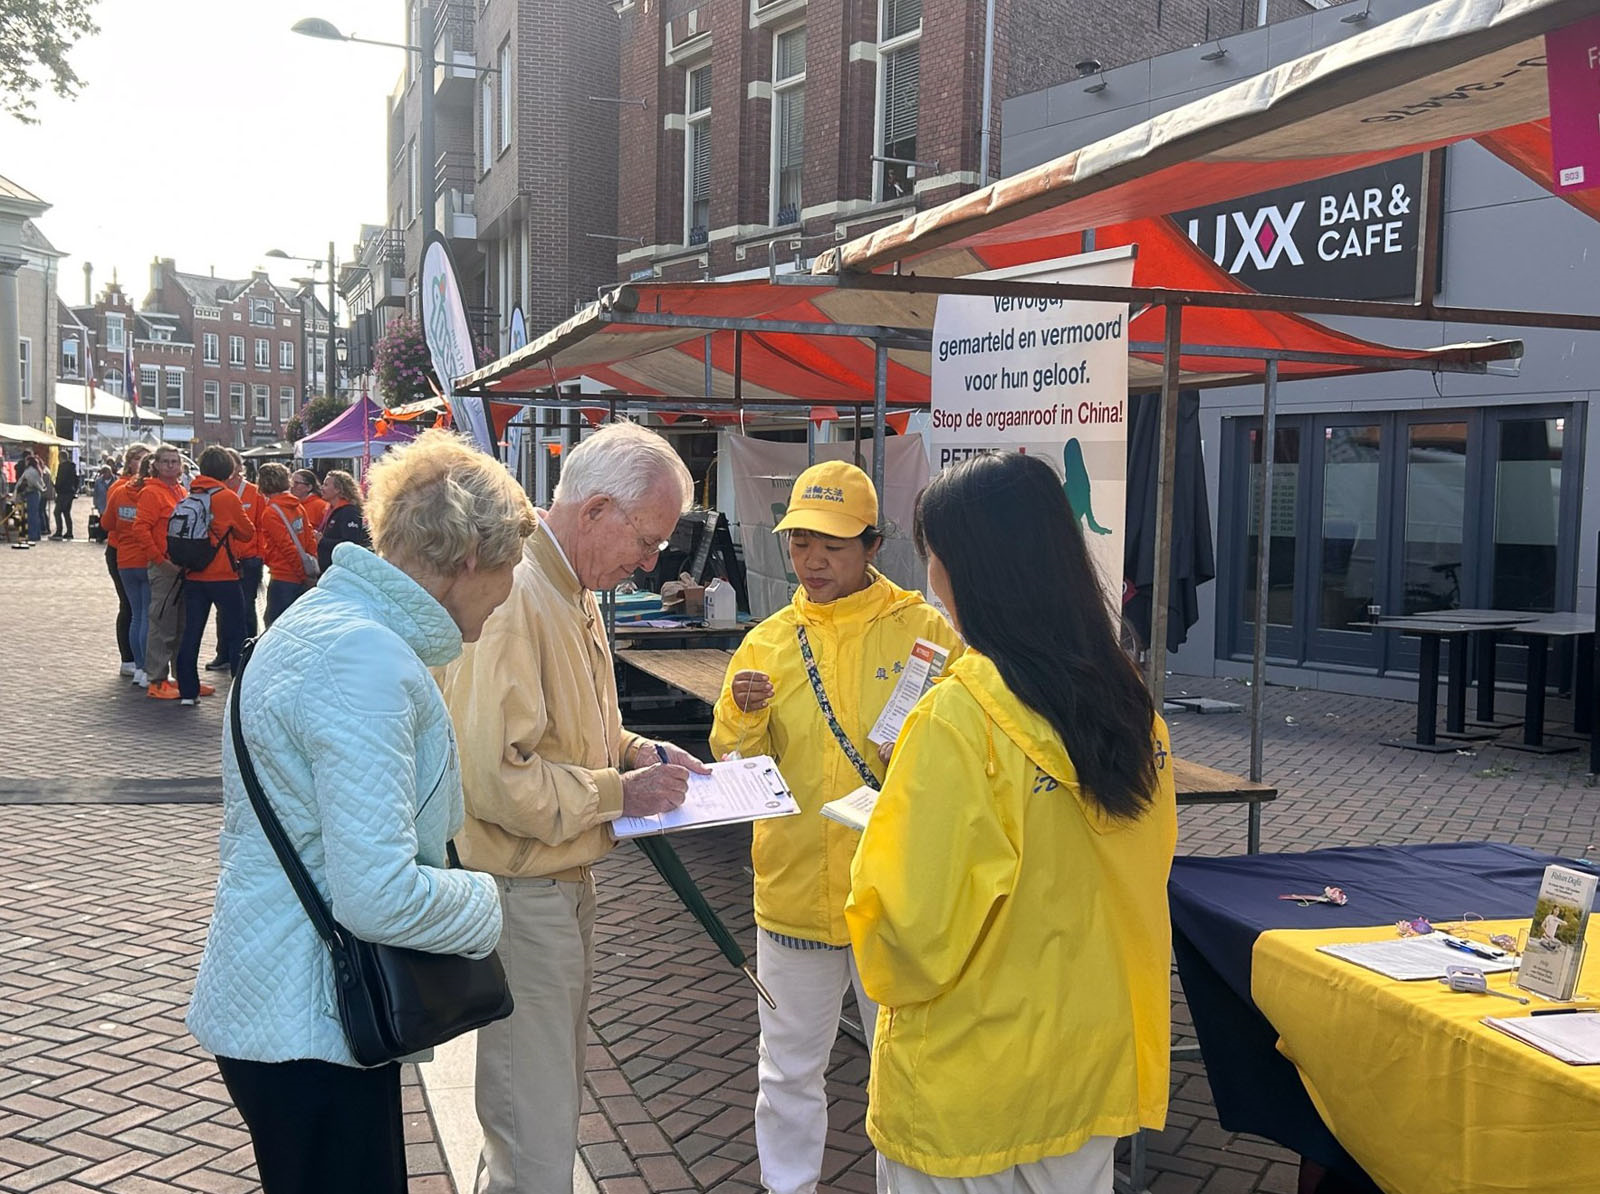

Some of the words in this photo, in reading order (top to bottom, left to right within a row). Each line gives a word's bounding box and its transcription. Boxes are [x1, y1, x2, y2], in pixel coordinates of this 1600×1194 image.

[1317, 220, 1403, 262] CAFE
[938, 328, 1015, 361] gemarteld
[1018, 330, 1036, 348] en
[1041, 314, 1122, 346] vermoord
[964, 372, 998, 391] voor
[1001, 367, 1028, 389] hun
[1032, 360, 1090, 392] geloof.
[932, 408, 962, 432] Stop
[966, 408, 982, 428] de
[986, 404, 1058, 431] orgaanroof
[1060, 404, 1073, 425] in
[1078, 400, 1123, 425] China!
